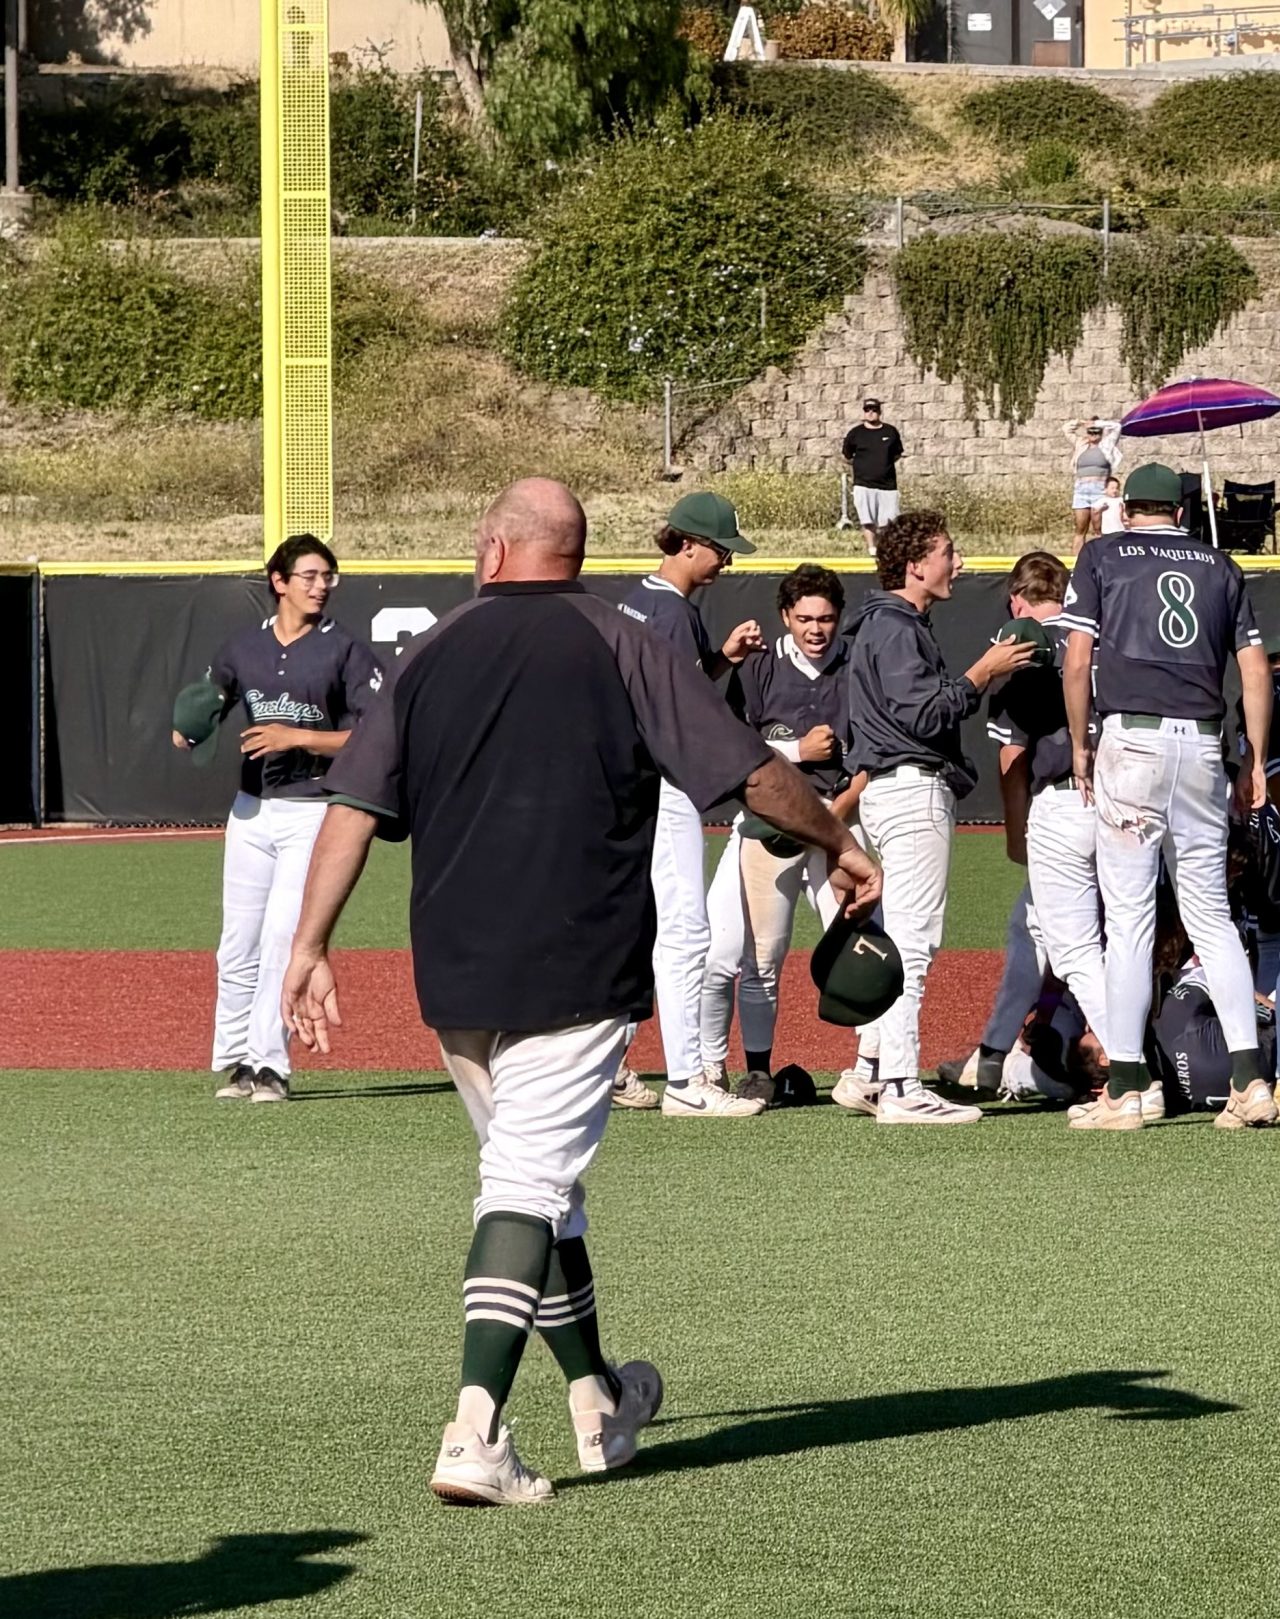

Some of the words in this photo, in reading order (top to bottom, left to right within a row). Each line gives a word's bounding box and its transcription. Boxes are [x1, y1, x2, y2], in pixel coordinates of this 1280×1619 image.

[1118, 545, 1146, 558] LOS
[1150, 546, 1216, 566] VAQUEROS
[1156, 570, 1199, 649] 8
[783, 1078, 795, 1096] L
